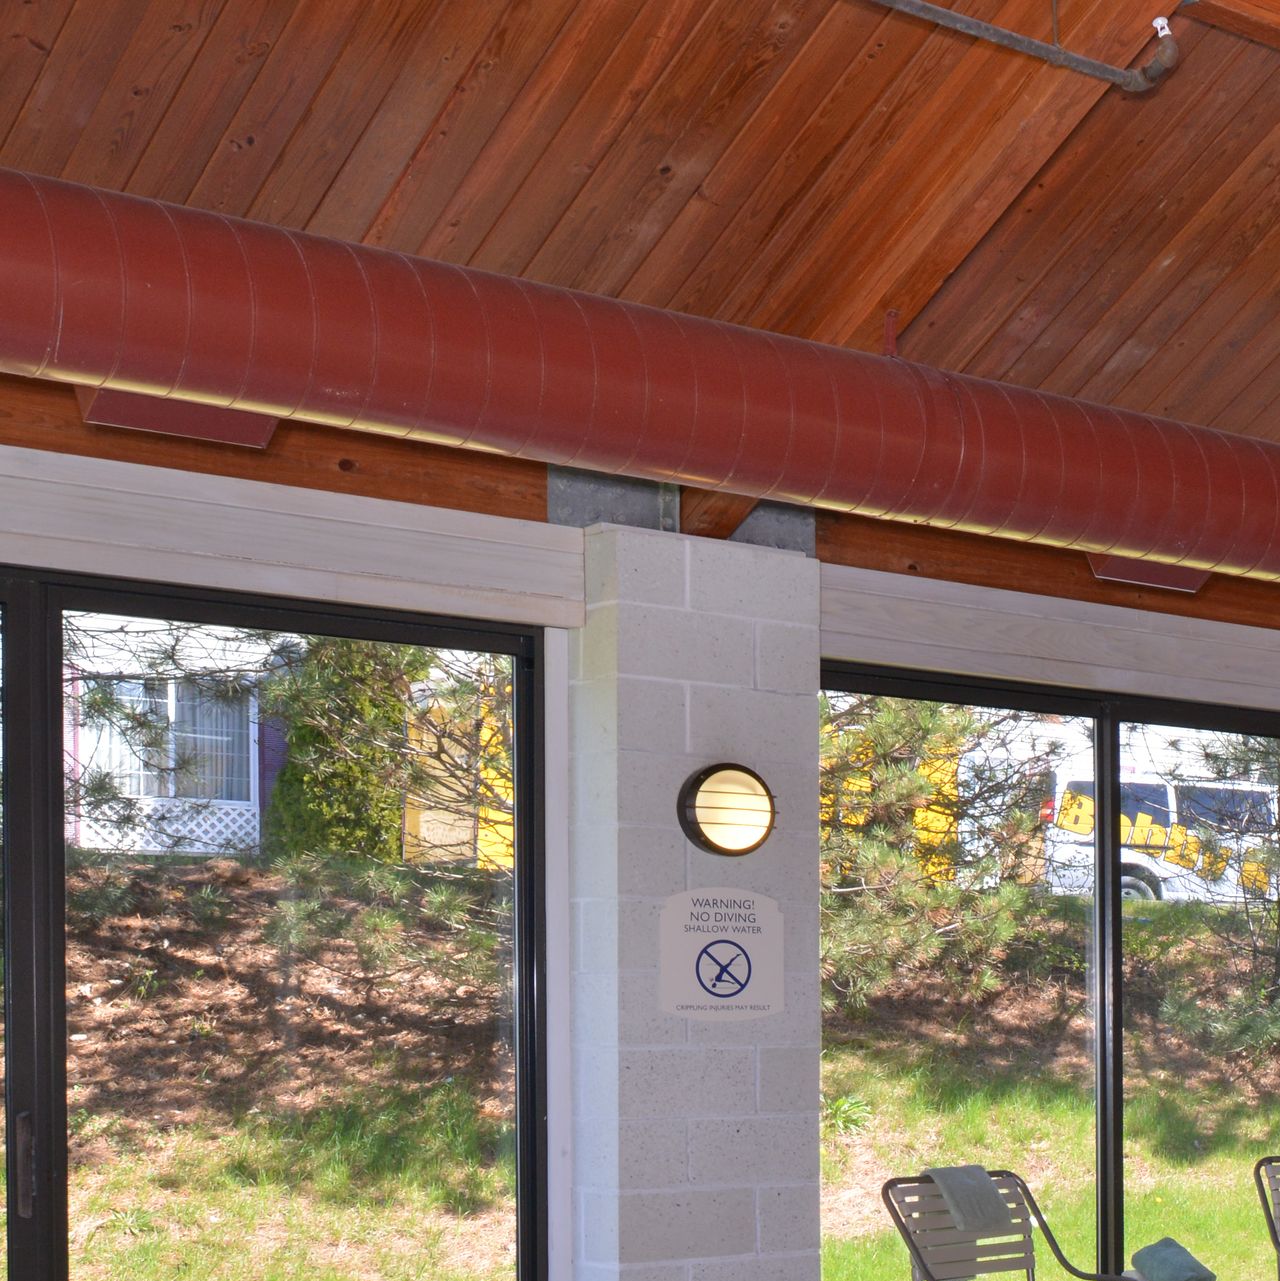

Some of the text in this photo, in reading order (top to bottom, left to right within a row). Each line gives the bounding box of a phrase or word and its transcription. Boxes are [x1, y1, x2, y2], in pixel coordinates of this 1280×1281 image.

[691, 898, 755, 910] WARNING!
[690, 912, 756, 923] NO DIVING
[684, 924, 762, 934] SHALLOW WATER
